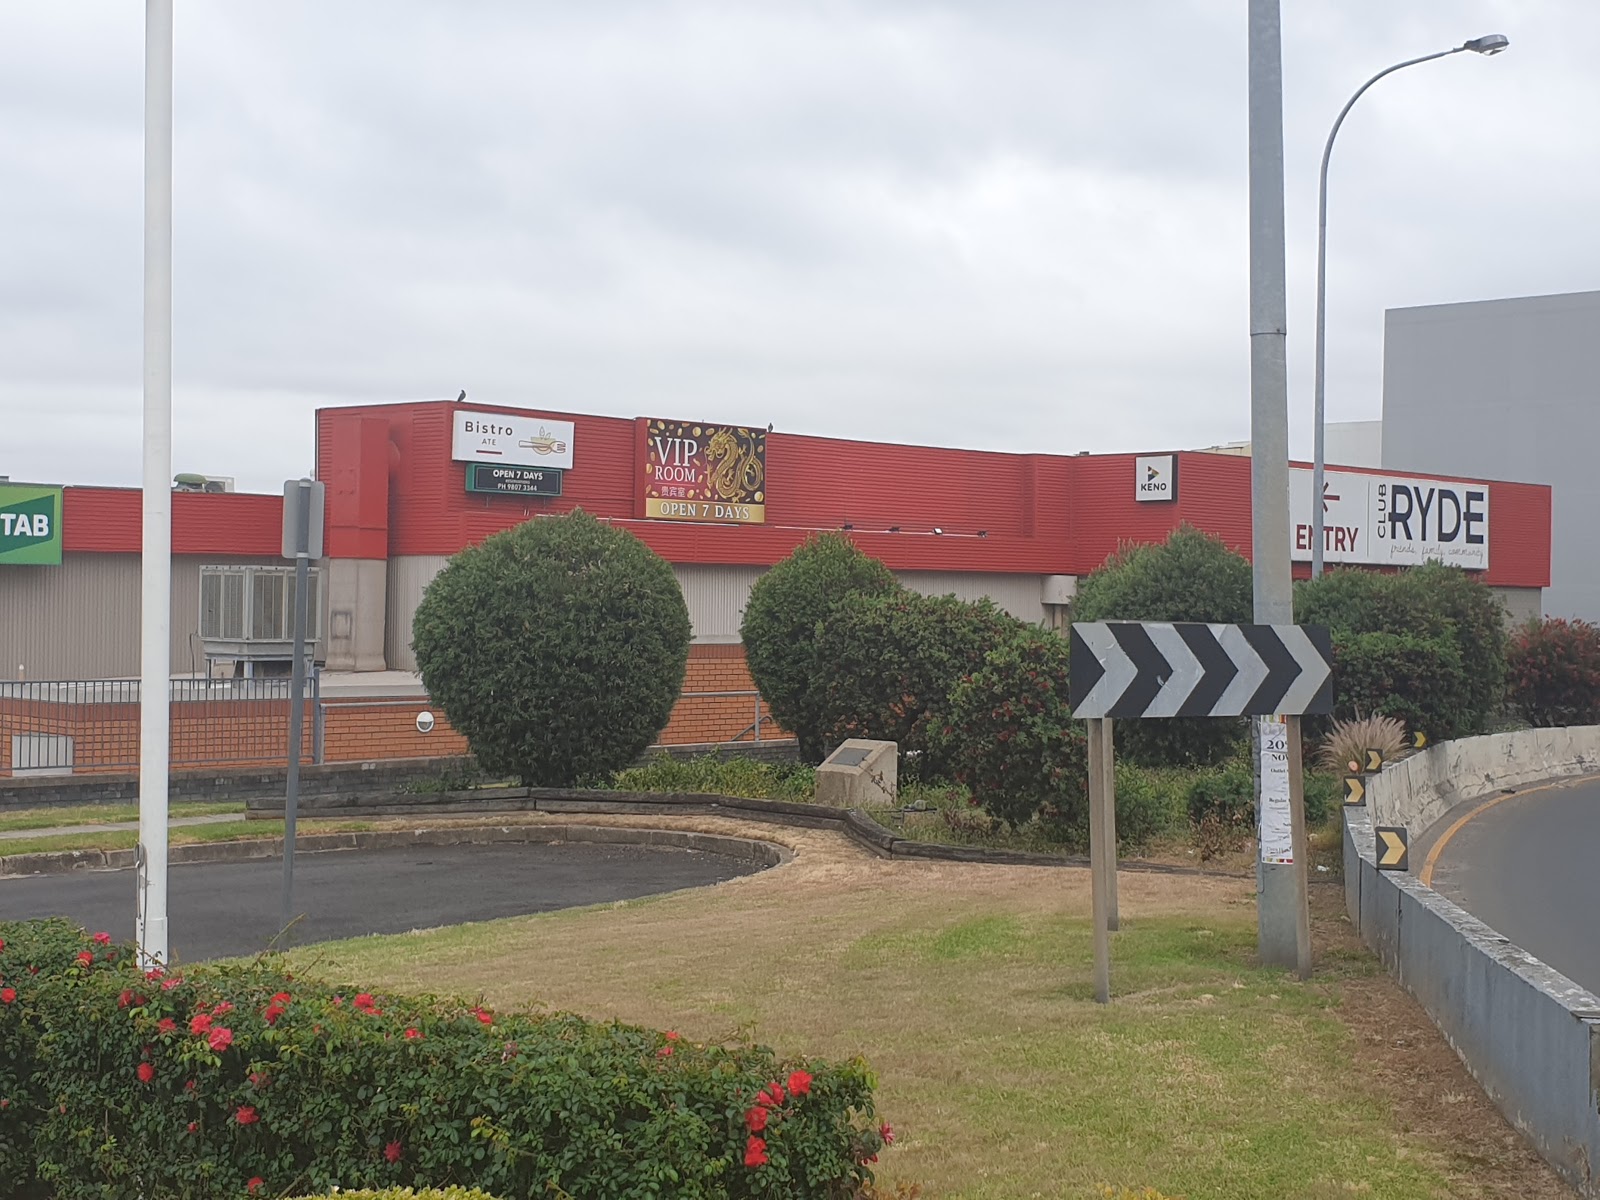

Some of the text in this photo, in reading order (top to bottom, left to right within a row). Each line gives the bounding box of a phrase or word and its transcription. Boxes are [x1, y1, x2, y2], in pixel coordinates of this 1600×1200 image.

[465, 421, 513, 436] Bistro
[481, 438, 497, 446] ATE
[654, 436, 698, 467] VIP
[492, 469, 544, 481] OPEN 7 DAYS
[654, 466, 696, 483] ROOM
[497, 482, 506, 490] PH
[1140, 482, 1167, 492] KENO
[660, 501, 750, 519] OPEN 7 DAYS
[1377, 483, 1387, 539] CLUB
[1388, 484, 1485, 545] RYDE
[0, 513, 50, 537] TAB
